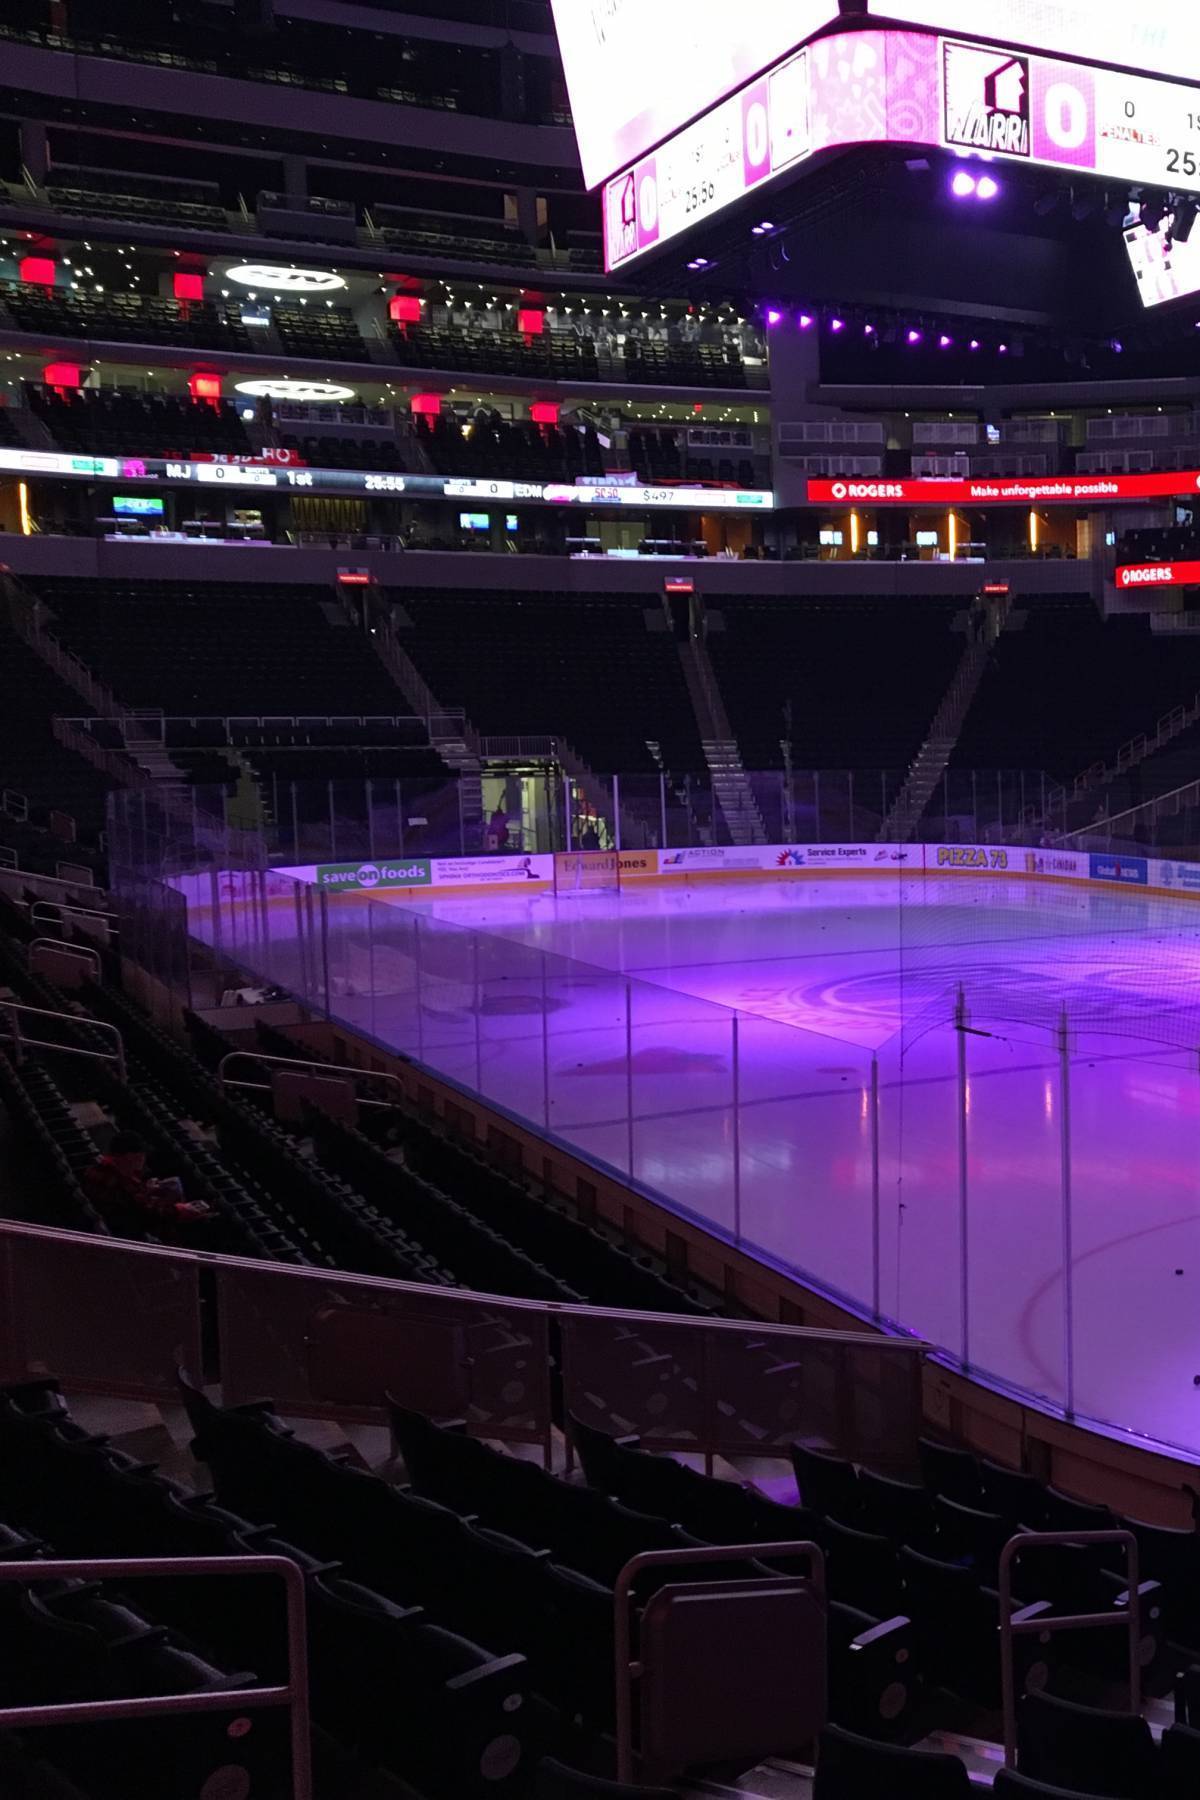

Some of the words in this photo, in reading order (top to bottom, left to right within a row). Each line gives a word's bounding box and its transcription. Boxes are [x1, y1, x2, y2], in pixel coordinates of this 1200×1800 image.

[1045, 82, 1087, 148] 0
[1124, 101, 1135, 118] 0
[745, 102, 768, 167] 0
[640, 174, 657, 232] 0
[166, 463, 191, 479] MJ
[216, 467, 225, 478] 0
[287, 470, 313, 486] 1st
[490, 484, 498, 494] 0
[515, 483, 543, 499] EDM
[643, 489, 675, 502] $497
[848, 484, 902, 498] ROGERS
[971, 486, 999, 496] Make
[1001, 484, 1072, 498] unforgettable
[1074, 482, 1118, 496] possible
[1130, 568, 1172, 583] ROGERS
[807, 848, 837, 857] Service
[838, 847, 867, 857] Experts
[937, 847, 988, 868] PIZZA
[990, 851, 1008, 869] 73
[564, 857, 611, 872] Edward
[609, 857, 647, 871] Jones
[322, 871, 356, 884] save
[358, 869, 379, 881] on
[380, 865, 425, 880] foods
